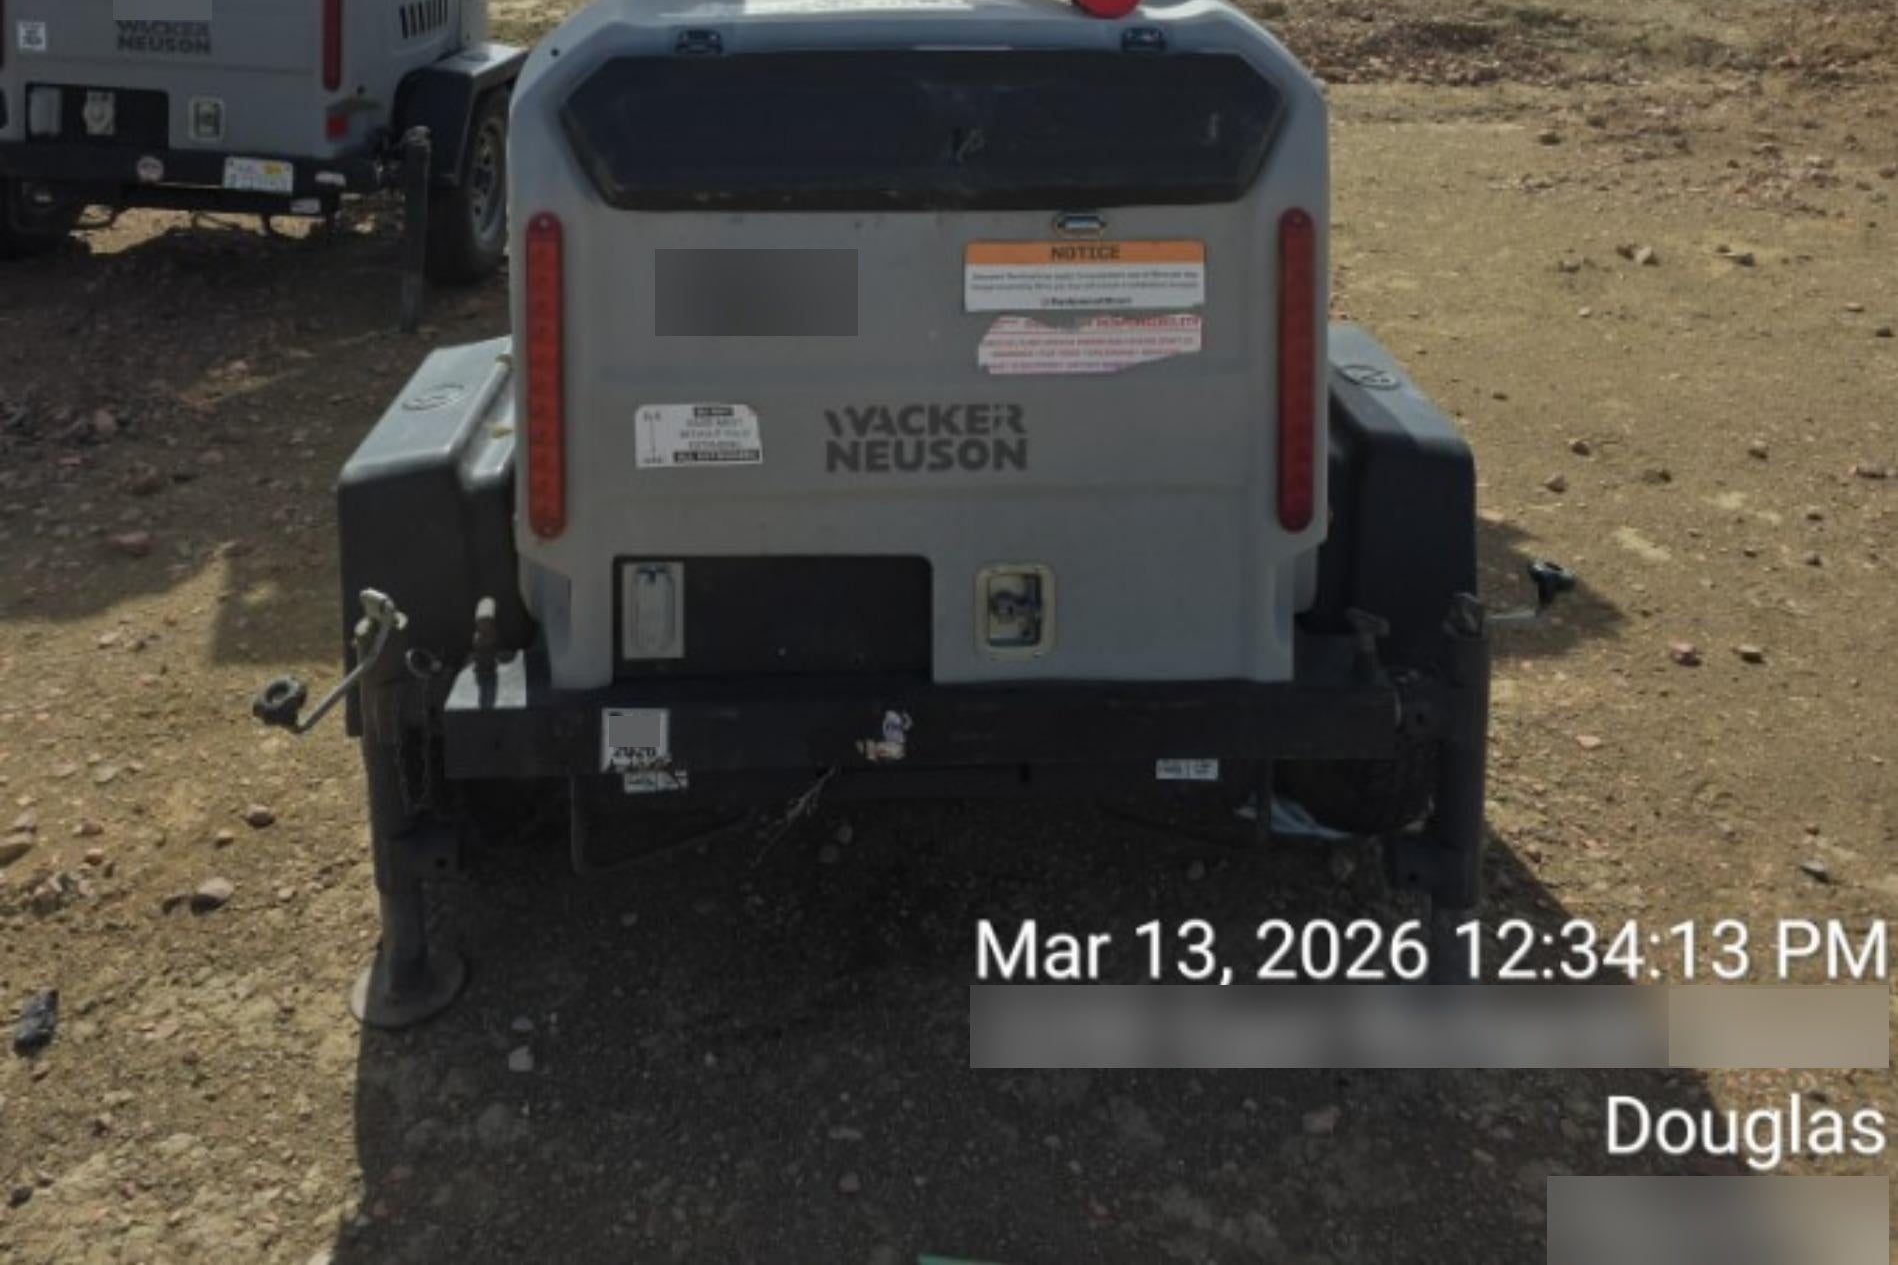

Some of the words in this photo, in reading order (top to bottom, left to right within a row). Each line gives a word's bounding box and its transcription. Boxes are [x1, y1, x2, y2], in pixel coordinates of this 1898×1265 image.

[116, 35, 212, 54] NEUSON
[1050, 245, 1121, 261] NOTICE
[825, 438, 1028, 473] NEUSON
